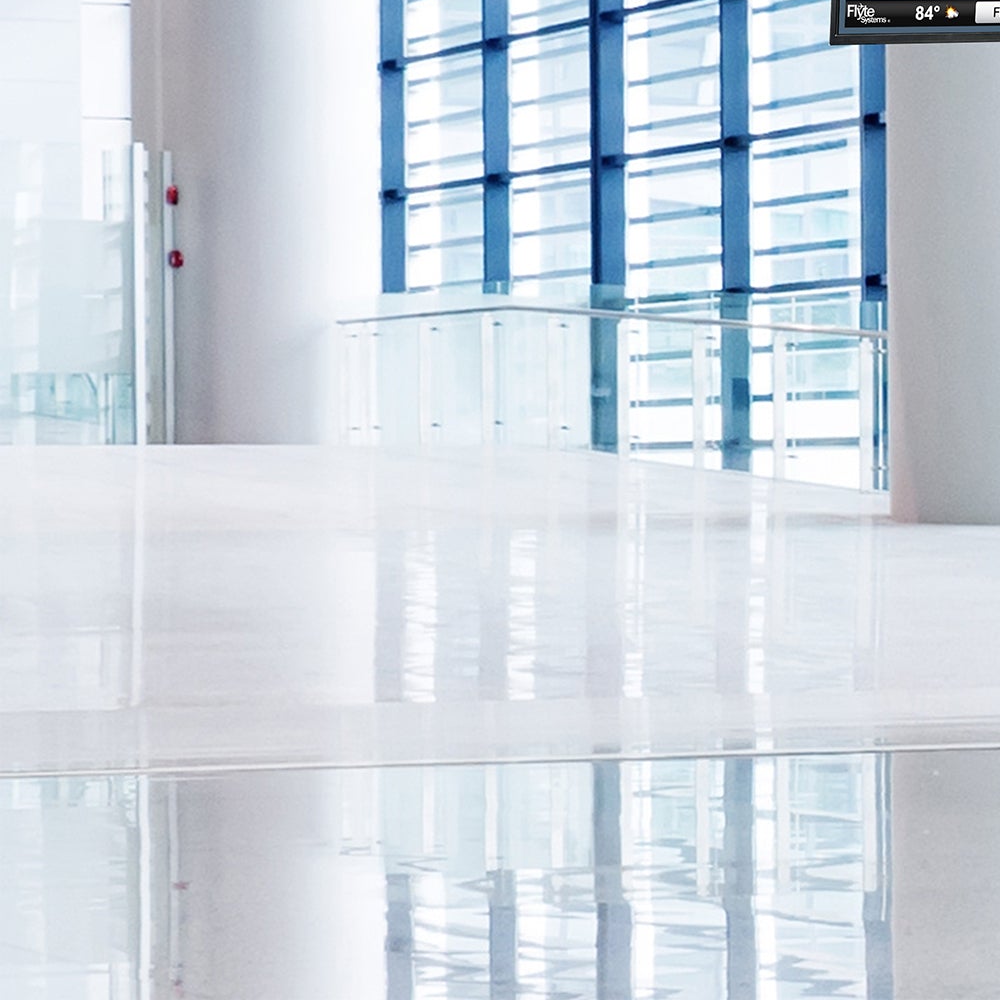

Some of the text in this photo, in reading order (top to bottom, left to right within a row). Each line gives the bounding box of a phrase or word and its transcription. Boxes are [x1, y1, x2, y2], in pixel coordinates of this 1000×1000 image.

[847, 3, 875, 20] Flyte
[915, 5, 941, 21] 84°
[860, 15, 887, 25] Systems
